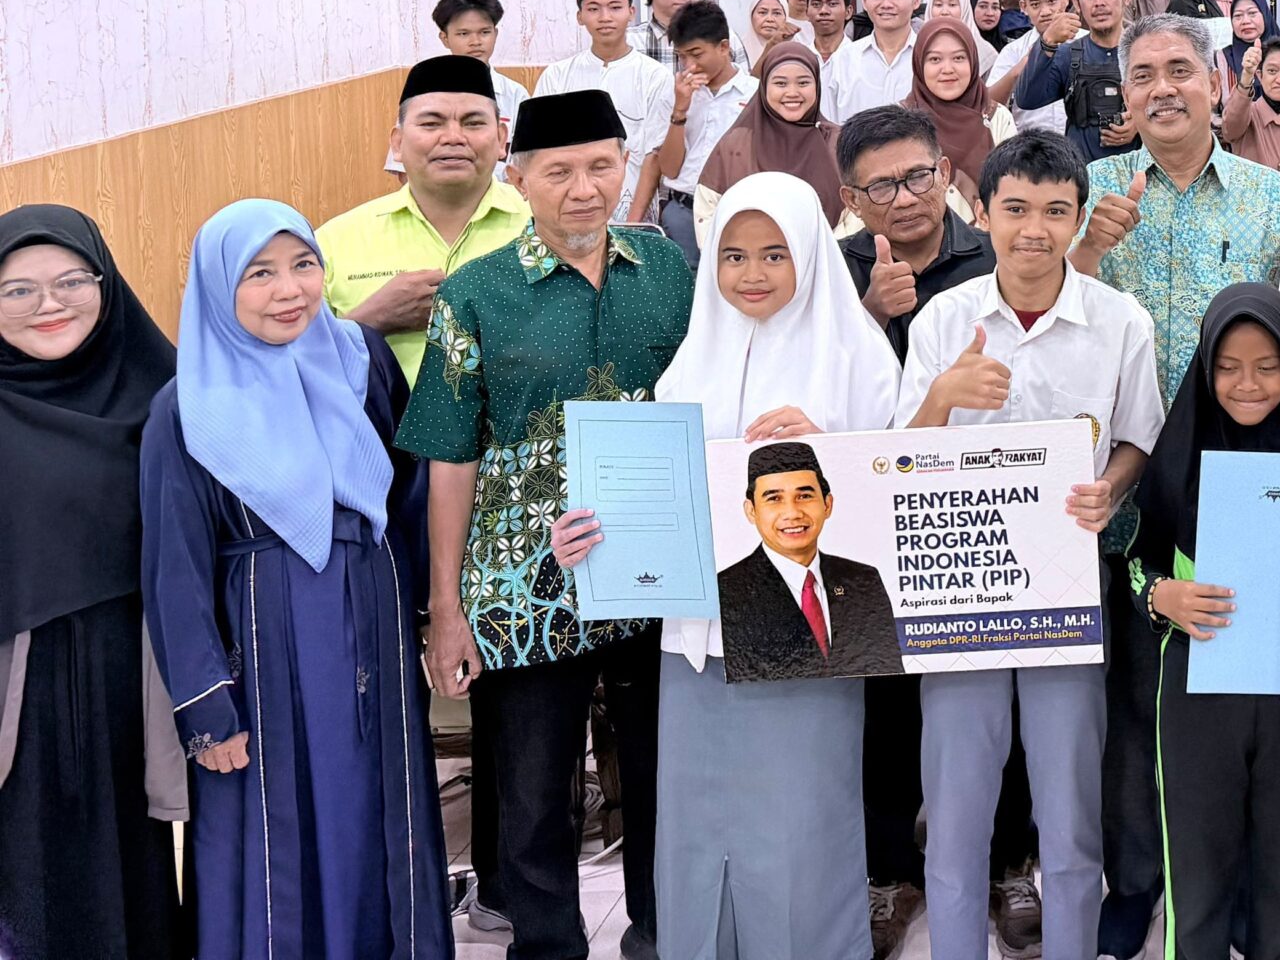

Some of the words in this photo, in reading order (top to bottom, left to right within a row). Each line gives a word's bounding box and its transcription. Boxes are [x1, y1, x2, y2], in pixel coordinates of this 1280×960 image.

[915, 452, 940, 461] Partai
[916, 459, 955, 468] NasDem
[965, 455, 991, 465] ANAK
[1005, 451, 1043, 463] RAKYAT
[893, 486, 1039, 511] PENYERAHAN
[895, 509, 1005, 531] BEASISWA
[896, 529, 1009, 552] PROGRAM
[897, 549, 1018, 571] INDONESIA
[899, 572, 976, 592] PINTAR
[982, 568, 1030, 591] (PIP)
[900, 596, 947, 609] Aspirasi
[950, 594, 973, 605] dari
[977, 592, 1013, 605] Bapak
[905, 620, 976, 636] RUDIANTO
[979, 617, 1026, 632] LALLO,
[1030, 615, 1061, 630] S.H.,
[1064, 613, 1095, 627] M.H.
[906, 637, 948, 648] Anggota
[949, 635, 981, 645] DPR-RI
[983, 633, 1012, 643] Fraksi
[1014, 631, 1042, 641] Partai
[1044, 629, 1082, 639] NasDem
